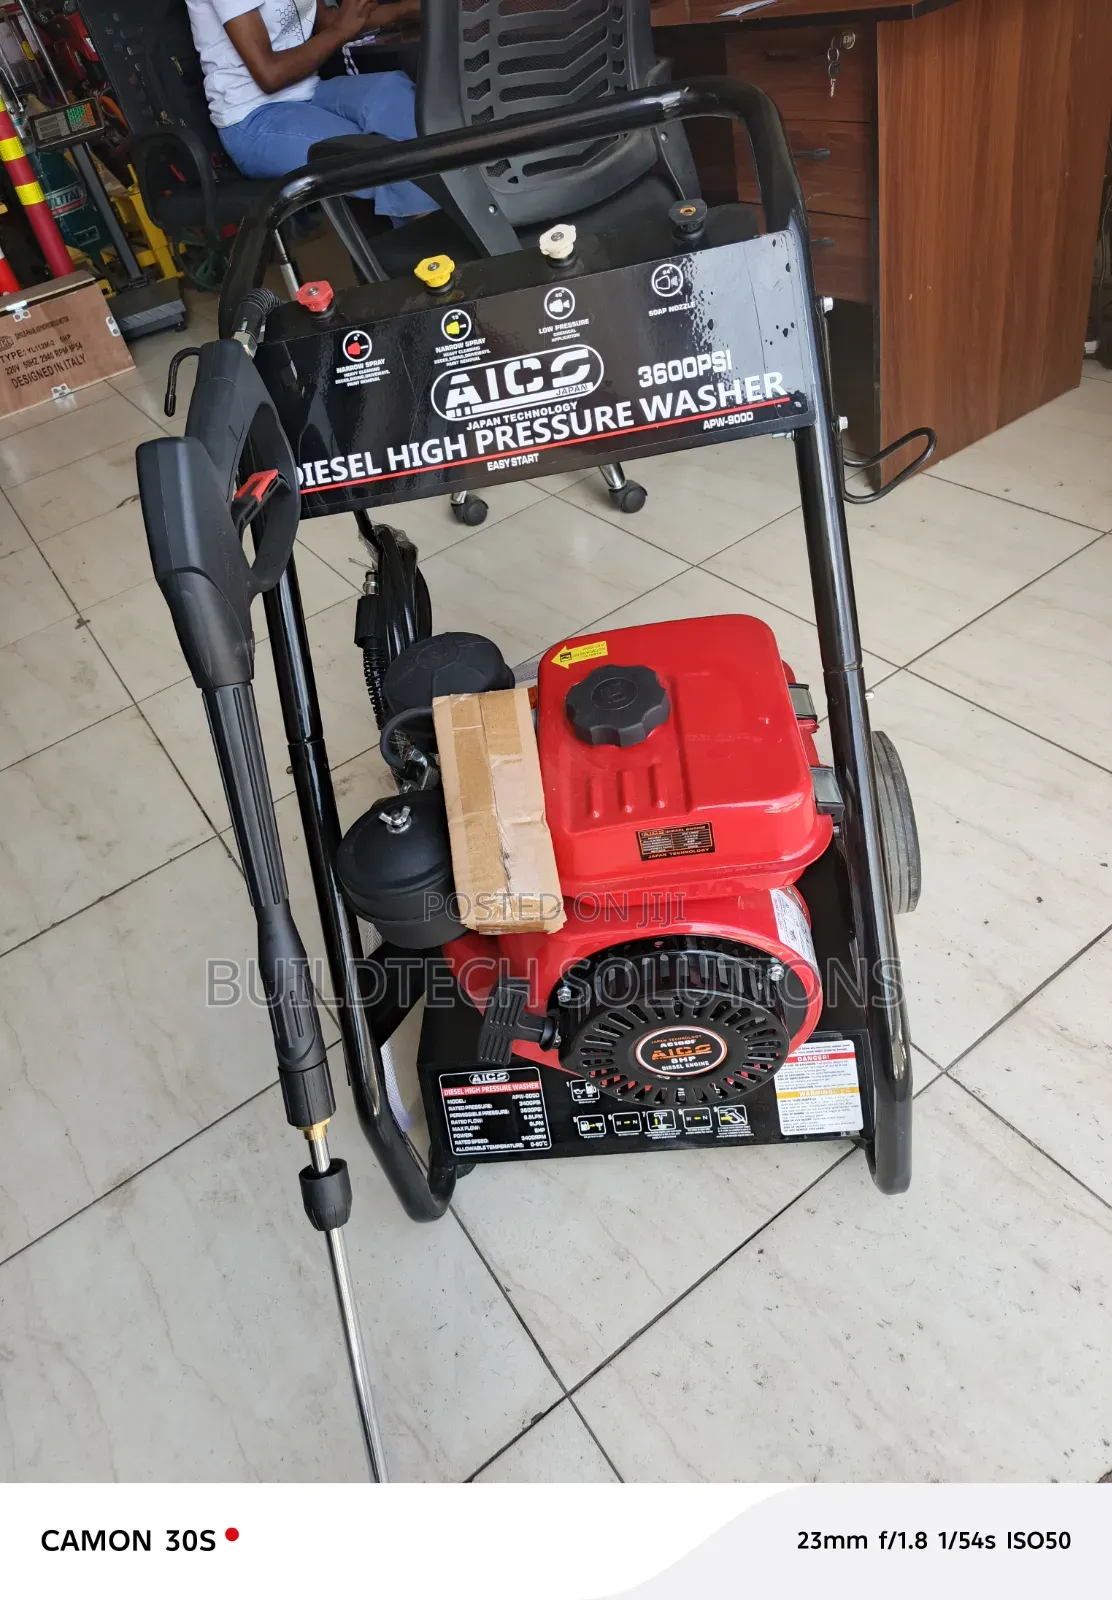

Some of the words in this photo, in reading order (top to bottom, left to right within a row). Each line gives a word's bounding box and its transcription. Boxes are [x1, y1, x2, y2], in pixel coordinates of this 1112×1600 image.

[648, 307, 667, 317] SOAP
[668, 301, 696, 313] NOZZLE
[538, 325, 554, 335] LOW
[554, 318, 590, 331] PRESSURE
[551, 332, 581, 342] APPLICATION
[435, 342, 464, 353] NARROW
[464, 337, 486, 347] SPRAY
[458, 346, 481, 354] CLEANING
[0, 349, 27, 363] TYPE:
[5, 364, 21, 375] 220V
[23, 357, 39, 369] 50HZ
[55, 347, 69, 358] RPM
[460, 356, 481, 364] REMOVAL
[11, 365, 55, 388] DESIGNED
[55, 361, 62, 373] IN
[62, 353, 86, 371] ITALY
[336, 362, 364, 373] NARROW
[365, 358, 386, 368] SPRAY
[358, 366, 381, 375] CLEANING
[637, 350, 733, 388] 3600PSI
[556, 383, 588, 396] JAPAN
[387, 433, 468, 471] HIGH
[474, 401, 635, 455] PRESSURE
[639, 371, 789, 421] WASHER
[466, 416, 501, 431] JAPAN
[503, 401, 578, 423] TECHNOLOGY
[486, 458, 512, 471] EASY
[512, 453, 540, 467] START
[669, 847, 710, 856] TECHNOLOGY
[661, 1063, 685, 1071] DIESEL
[685, 1060, 710, 1068] ENGINE
[797, 1054, 830, 1063] DANGER!
[444, 1087, 464, 1096] DIESEL
[464, 1086, 481, 1095] HIGH
[481, 1084, 512, 1093] PRESSURE
[512, 1082, 540, 1091] WASHER
[482, 1108, 510, 1117] PRESSURE:
[455, 1145, 486, 1153] ALLOWABLE
[486, 1142, 524, 1151] TEMPERATURE:
